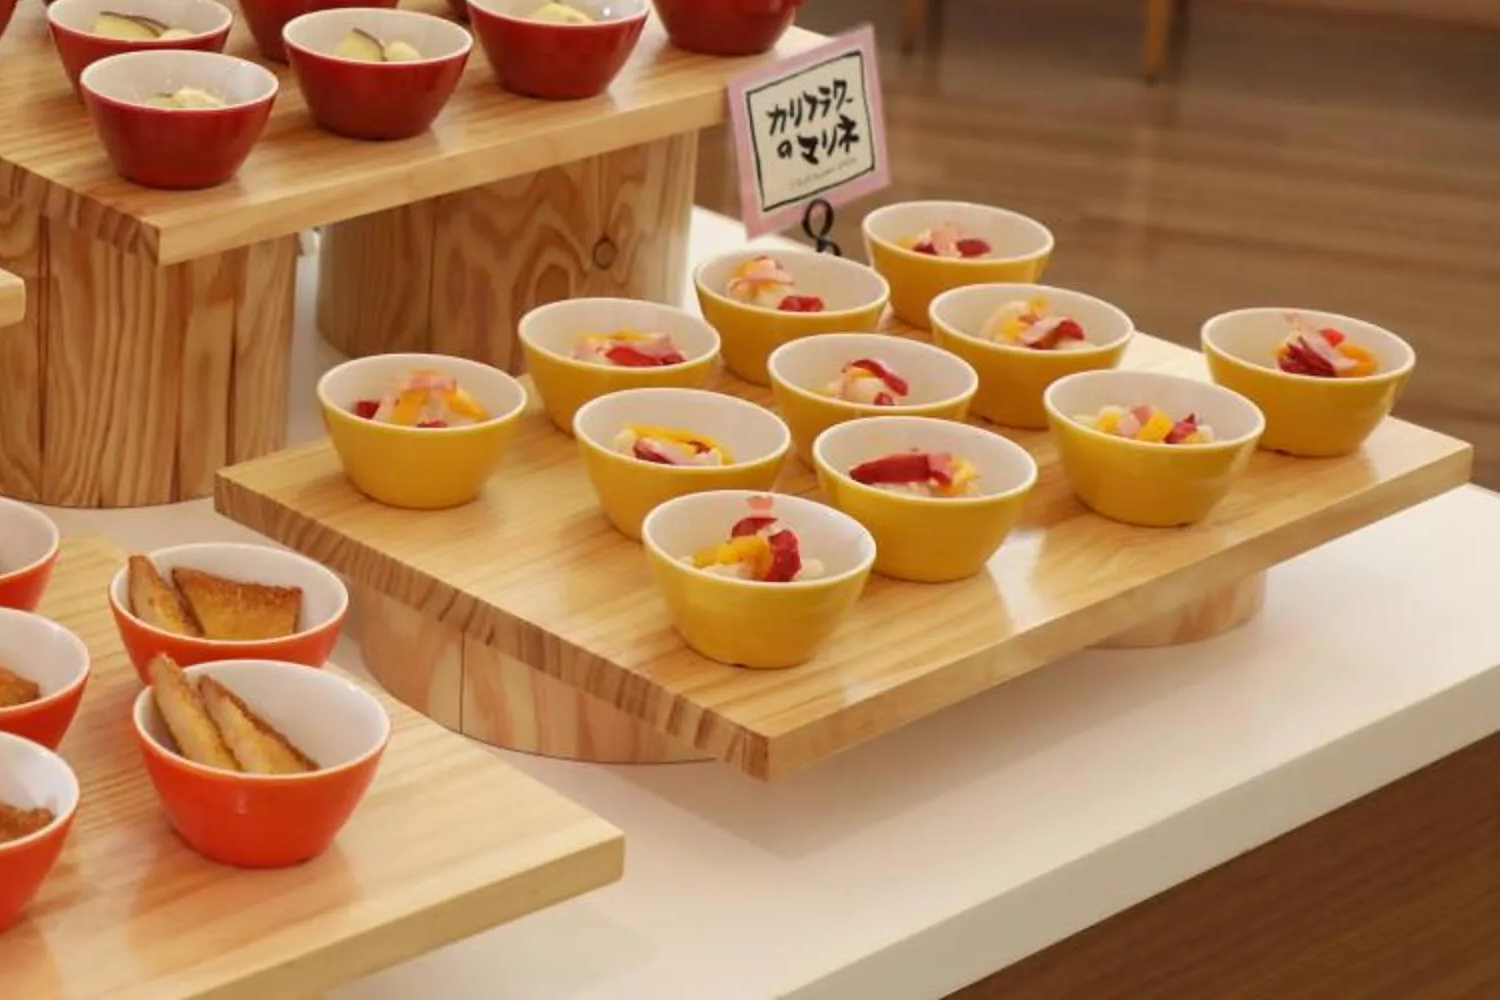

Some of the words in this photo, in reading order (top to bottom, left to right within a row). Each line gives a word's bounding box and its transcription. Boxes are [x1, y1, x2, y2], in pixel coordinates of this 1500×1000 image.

[766, 78, 854, 137] カリフラワー
[776, 113, 861, 166] のマリネ
